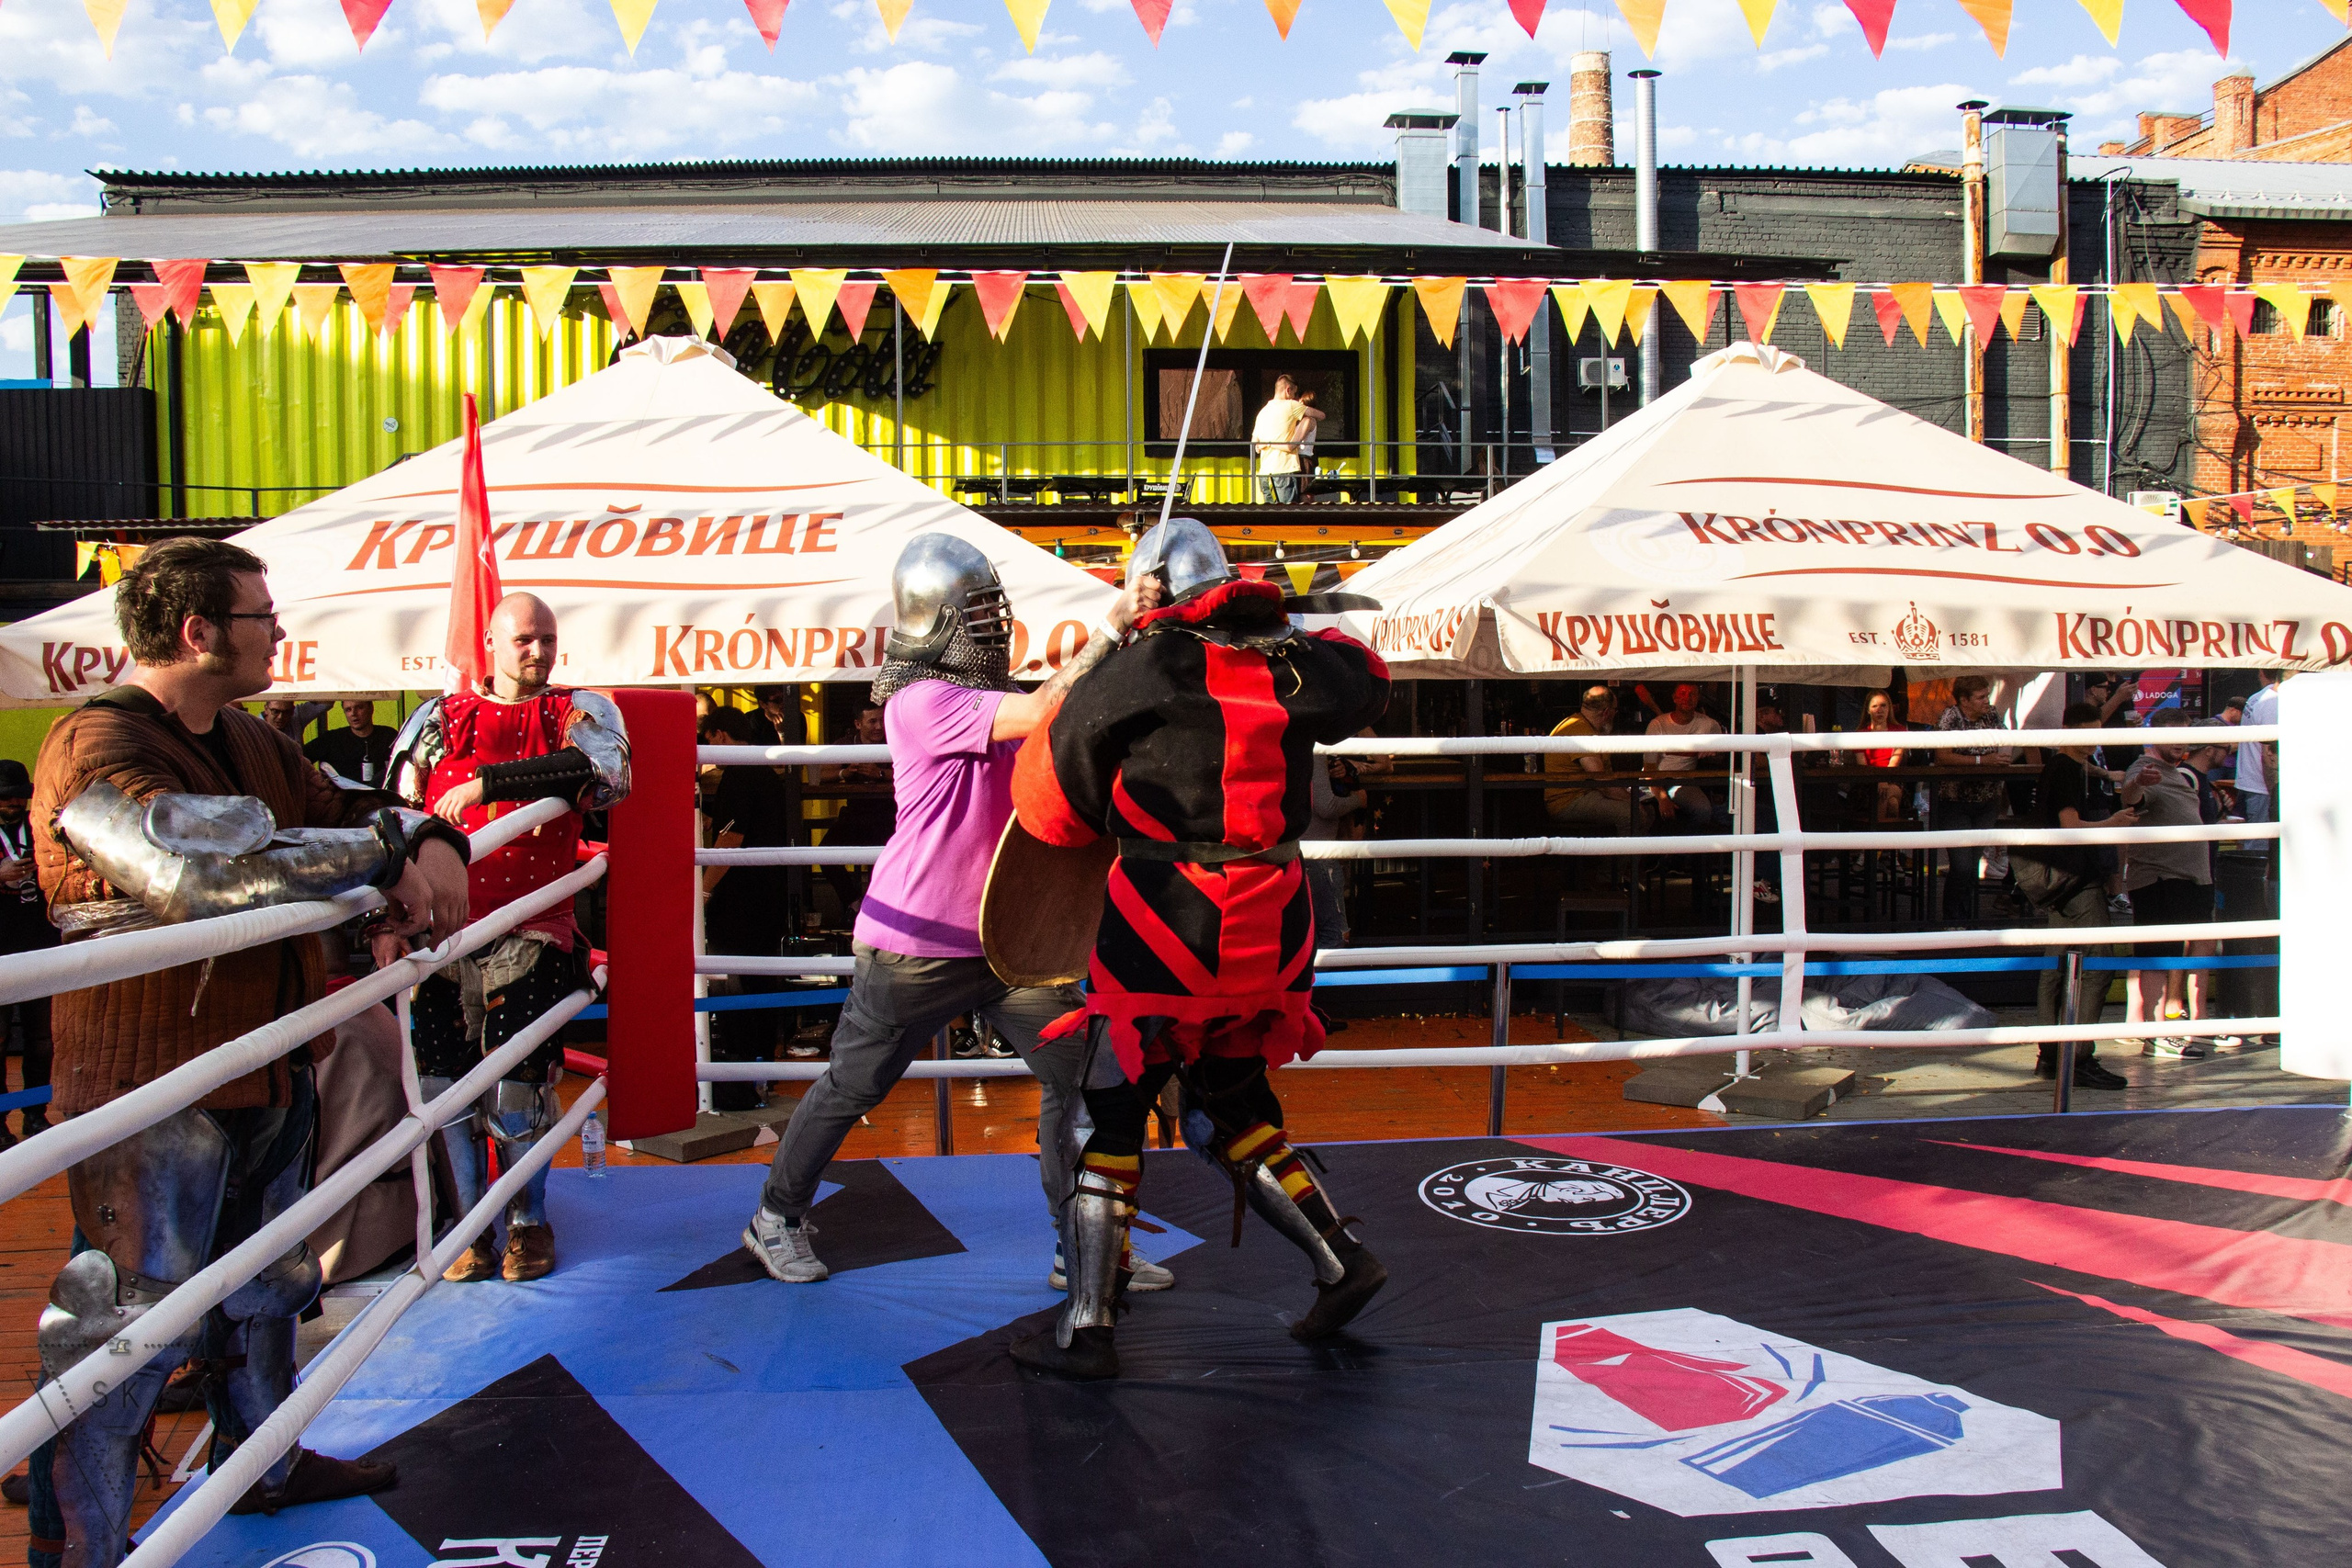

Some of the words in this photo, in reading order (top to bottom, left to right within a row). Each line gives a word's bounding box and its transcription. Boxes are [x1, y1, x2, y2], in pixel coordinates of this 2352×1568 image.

[1676, 508, 2023, 553] KRÓNPRINZ
[650, 612, 893, 678] KRÓNPRI
[1848, 631, 1887, 646] EST.
[1948, 632, 1990, 648] 1581
[2053, 605, 2309, 661] KRÓNPRINZ
[401, 656, 445, 671] EST.
